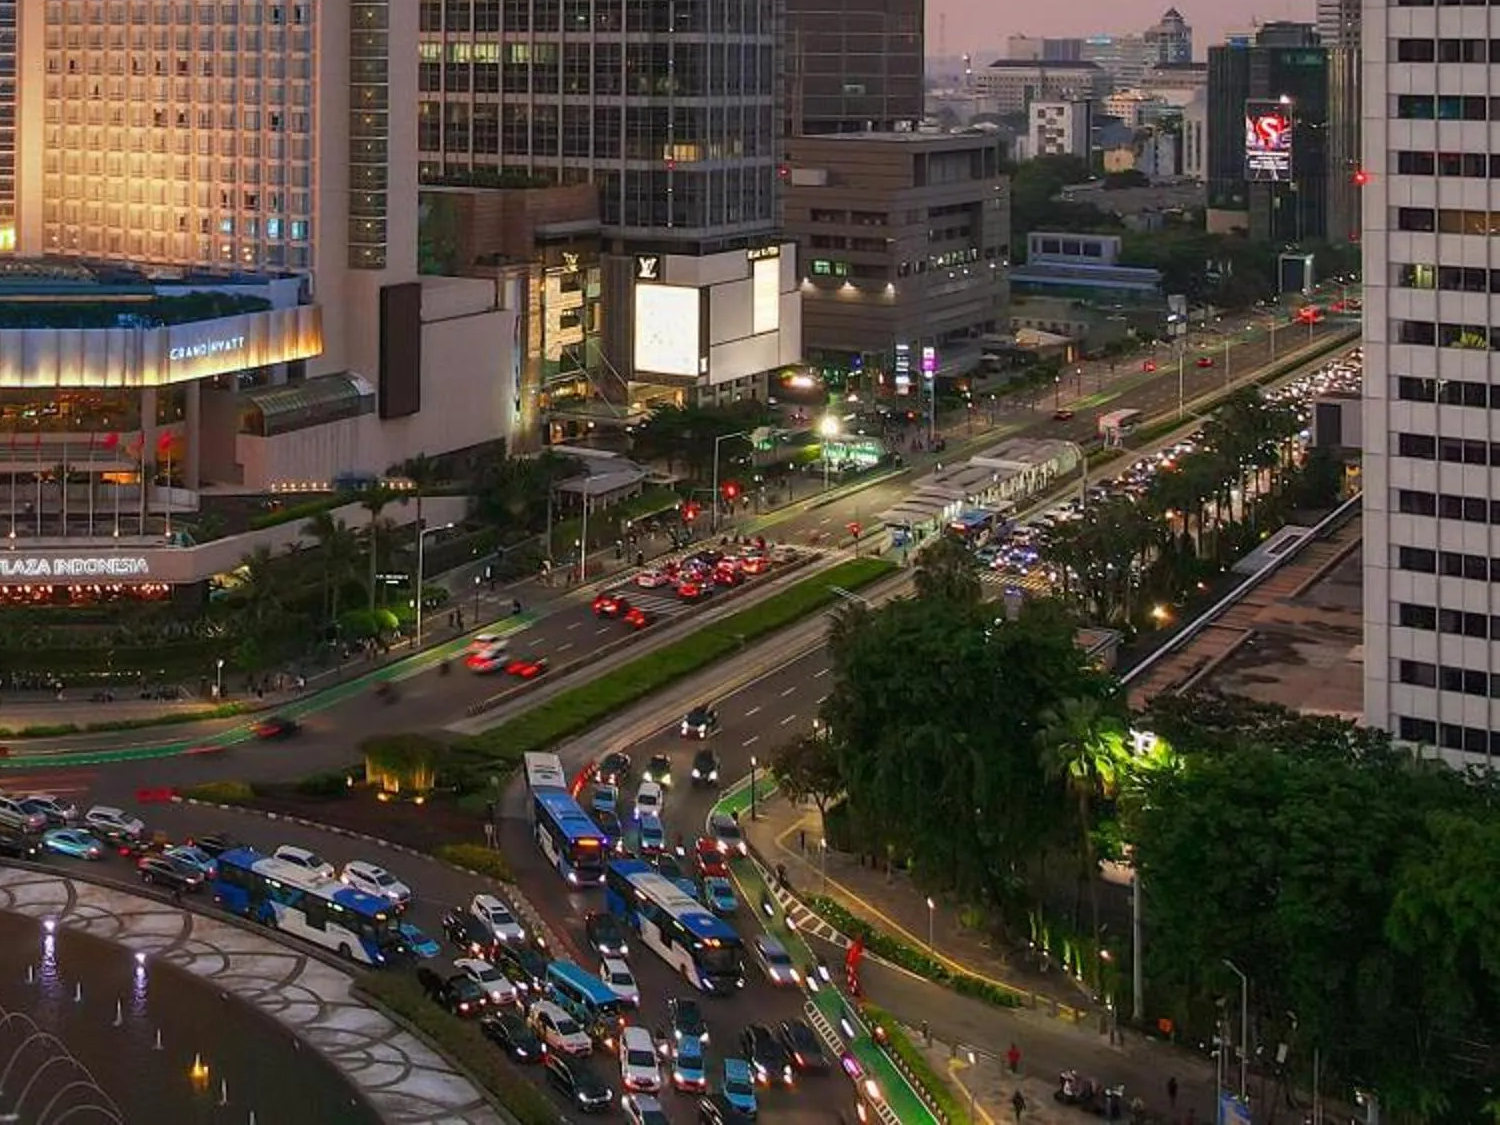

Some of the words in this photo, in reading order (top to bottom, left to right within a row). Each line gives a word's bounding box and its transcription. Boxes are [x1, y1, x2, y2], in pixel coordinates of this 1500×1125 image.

[169, 343, 207, 361] GRAND
[211, 336, 245, 352] HYATT
[53, 557, 149, 575] INDONESIA
